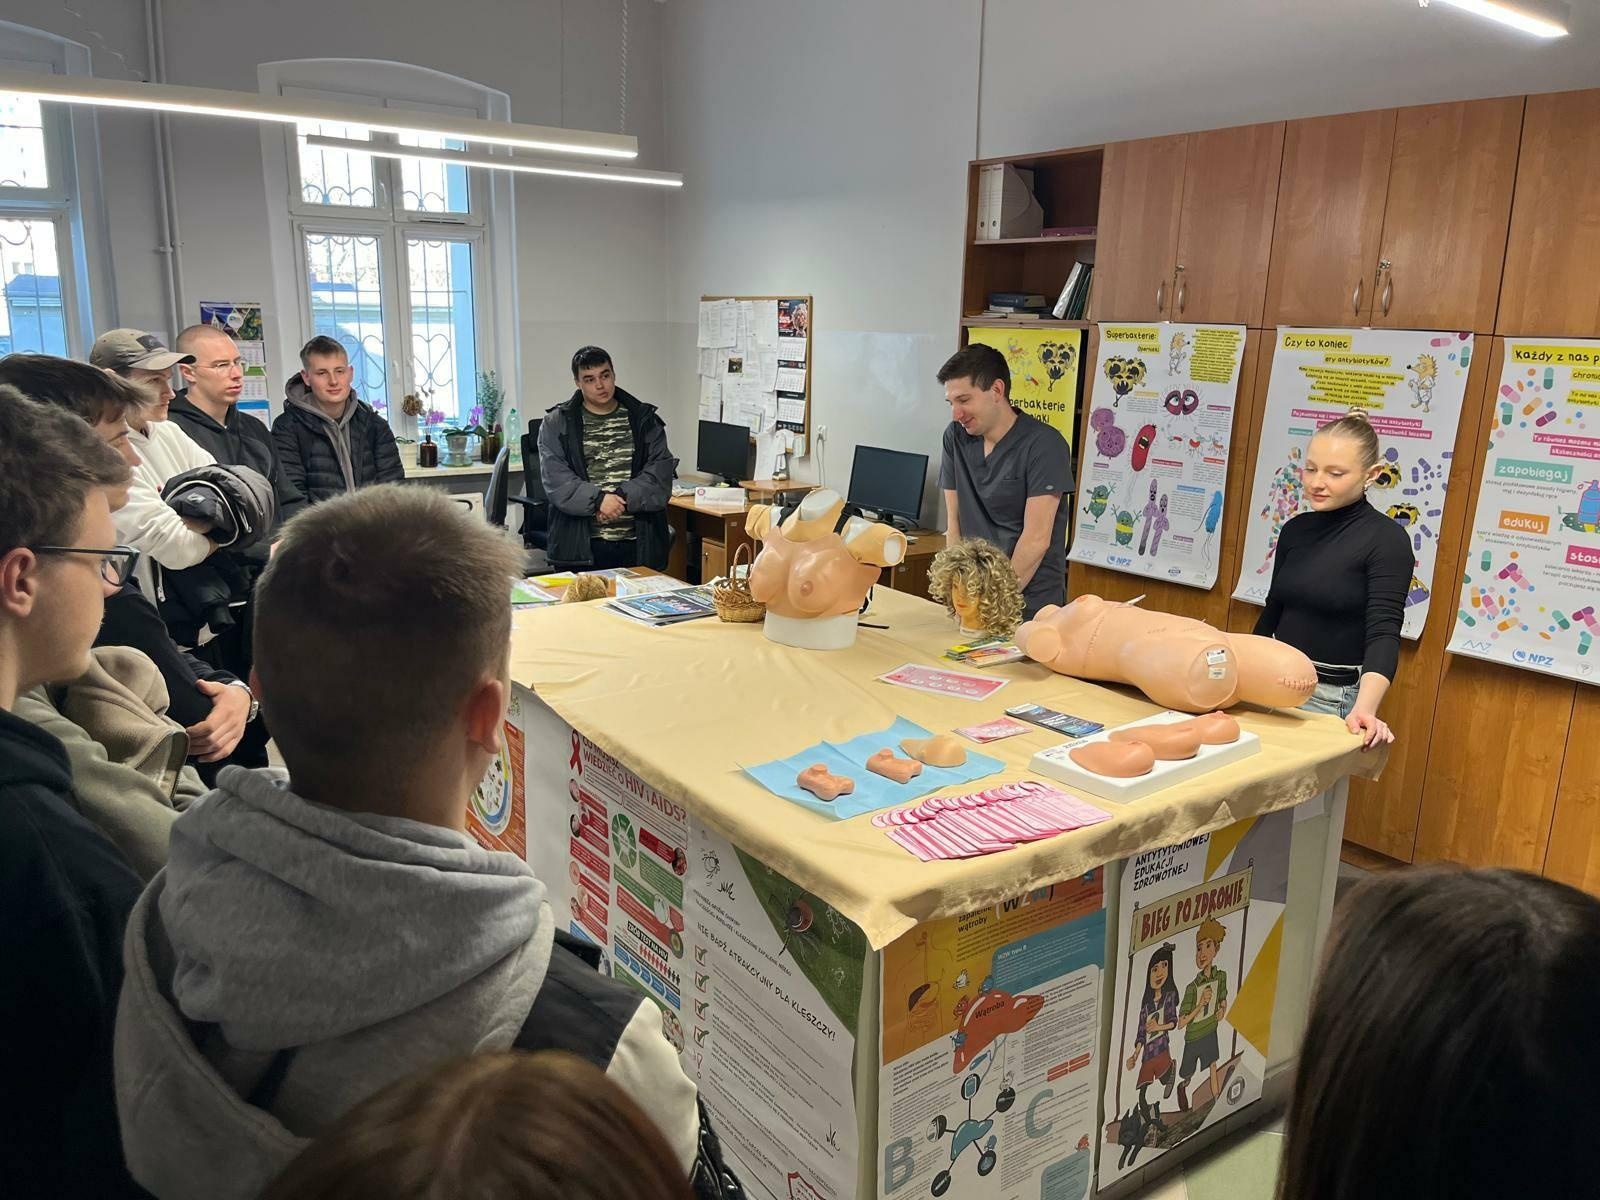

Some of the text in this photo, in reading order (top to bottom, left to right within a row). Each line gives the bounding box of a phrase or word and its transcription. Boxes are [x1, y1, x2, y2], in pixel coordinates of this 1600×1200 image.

[1285, 336, 1302, 348] Czy
[1305, 339, 1315, 347] to
[1515, 350, 1553, 362] Każdy
[1568, 353, 1589, 361] nas
[1009, 398, 1066, 412] perbakterie
[1498, 465, 1569, 482] zapobiegaj
[1503, 518, 1545, 532] edukuj
[1569, 552, 1600, 565] stos
[1528, 653, 1555, 667] NPZ
[625, 773, 645, 798] HIV
[651, 791, 688, 826] AIDS?
[1135, 832, 1210, 868] ANTYTYTONIOWEJ
[1133, 862, 1189, 892] ZDROWOTNEJ
[1134, 856, 1174, 881] EDUKACJI
[1140, 905, 1170, 943] BIEG
[1175, 898, 1191, 927] PO
[1191, 877, 1245, 921] ZDROWIE
[957, 915, 988, 934] wątroby
[775, 986, 790, 1004] DLA
[791, 999, 837, 1042] KLESZCZY!
[974, 1000, 1006, 1019] Wątroba
[1025, 1088, 1054, 1139] C
[884, 1136, 914, 1196] B
